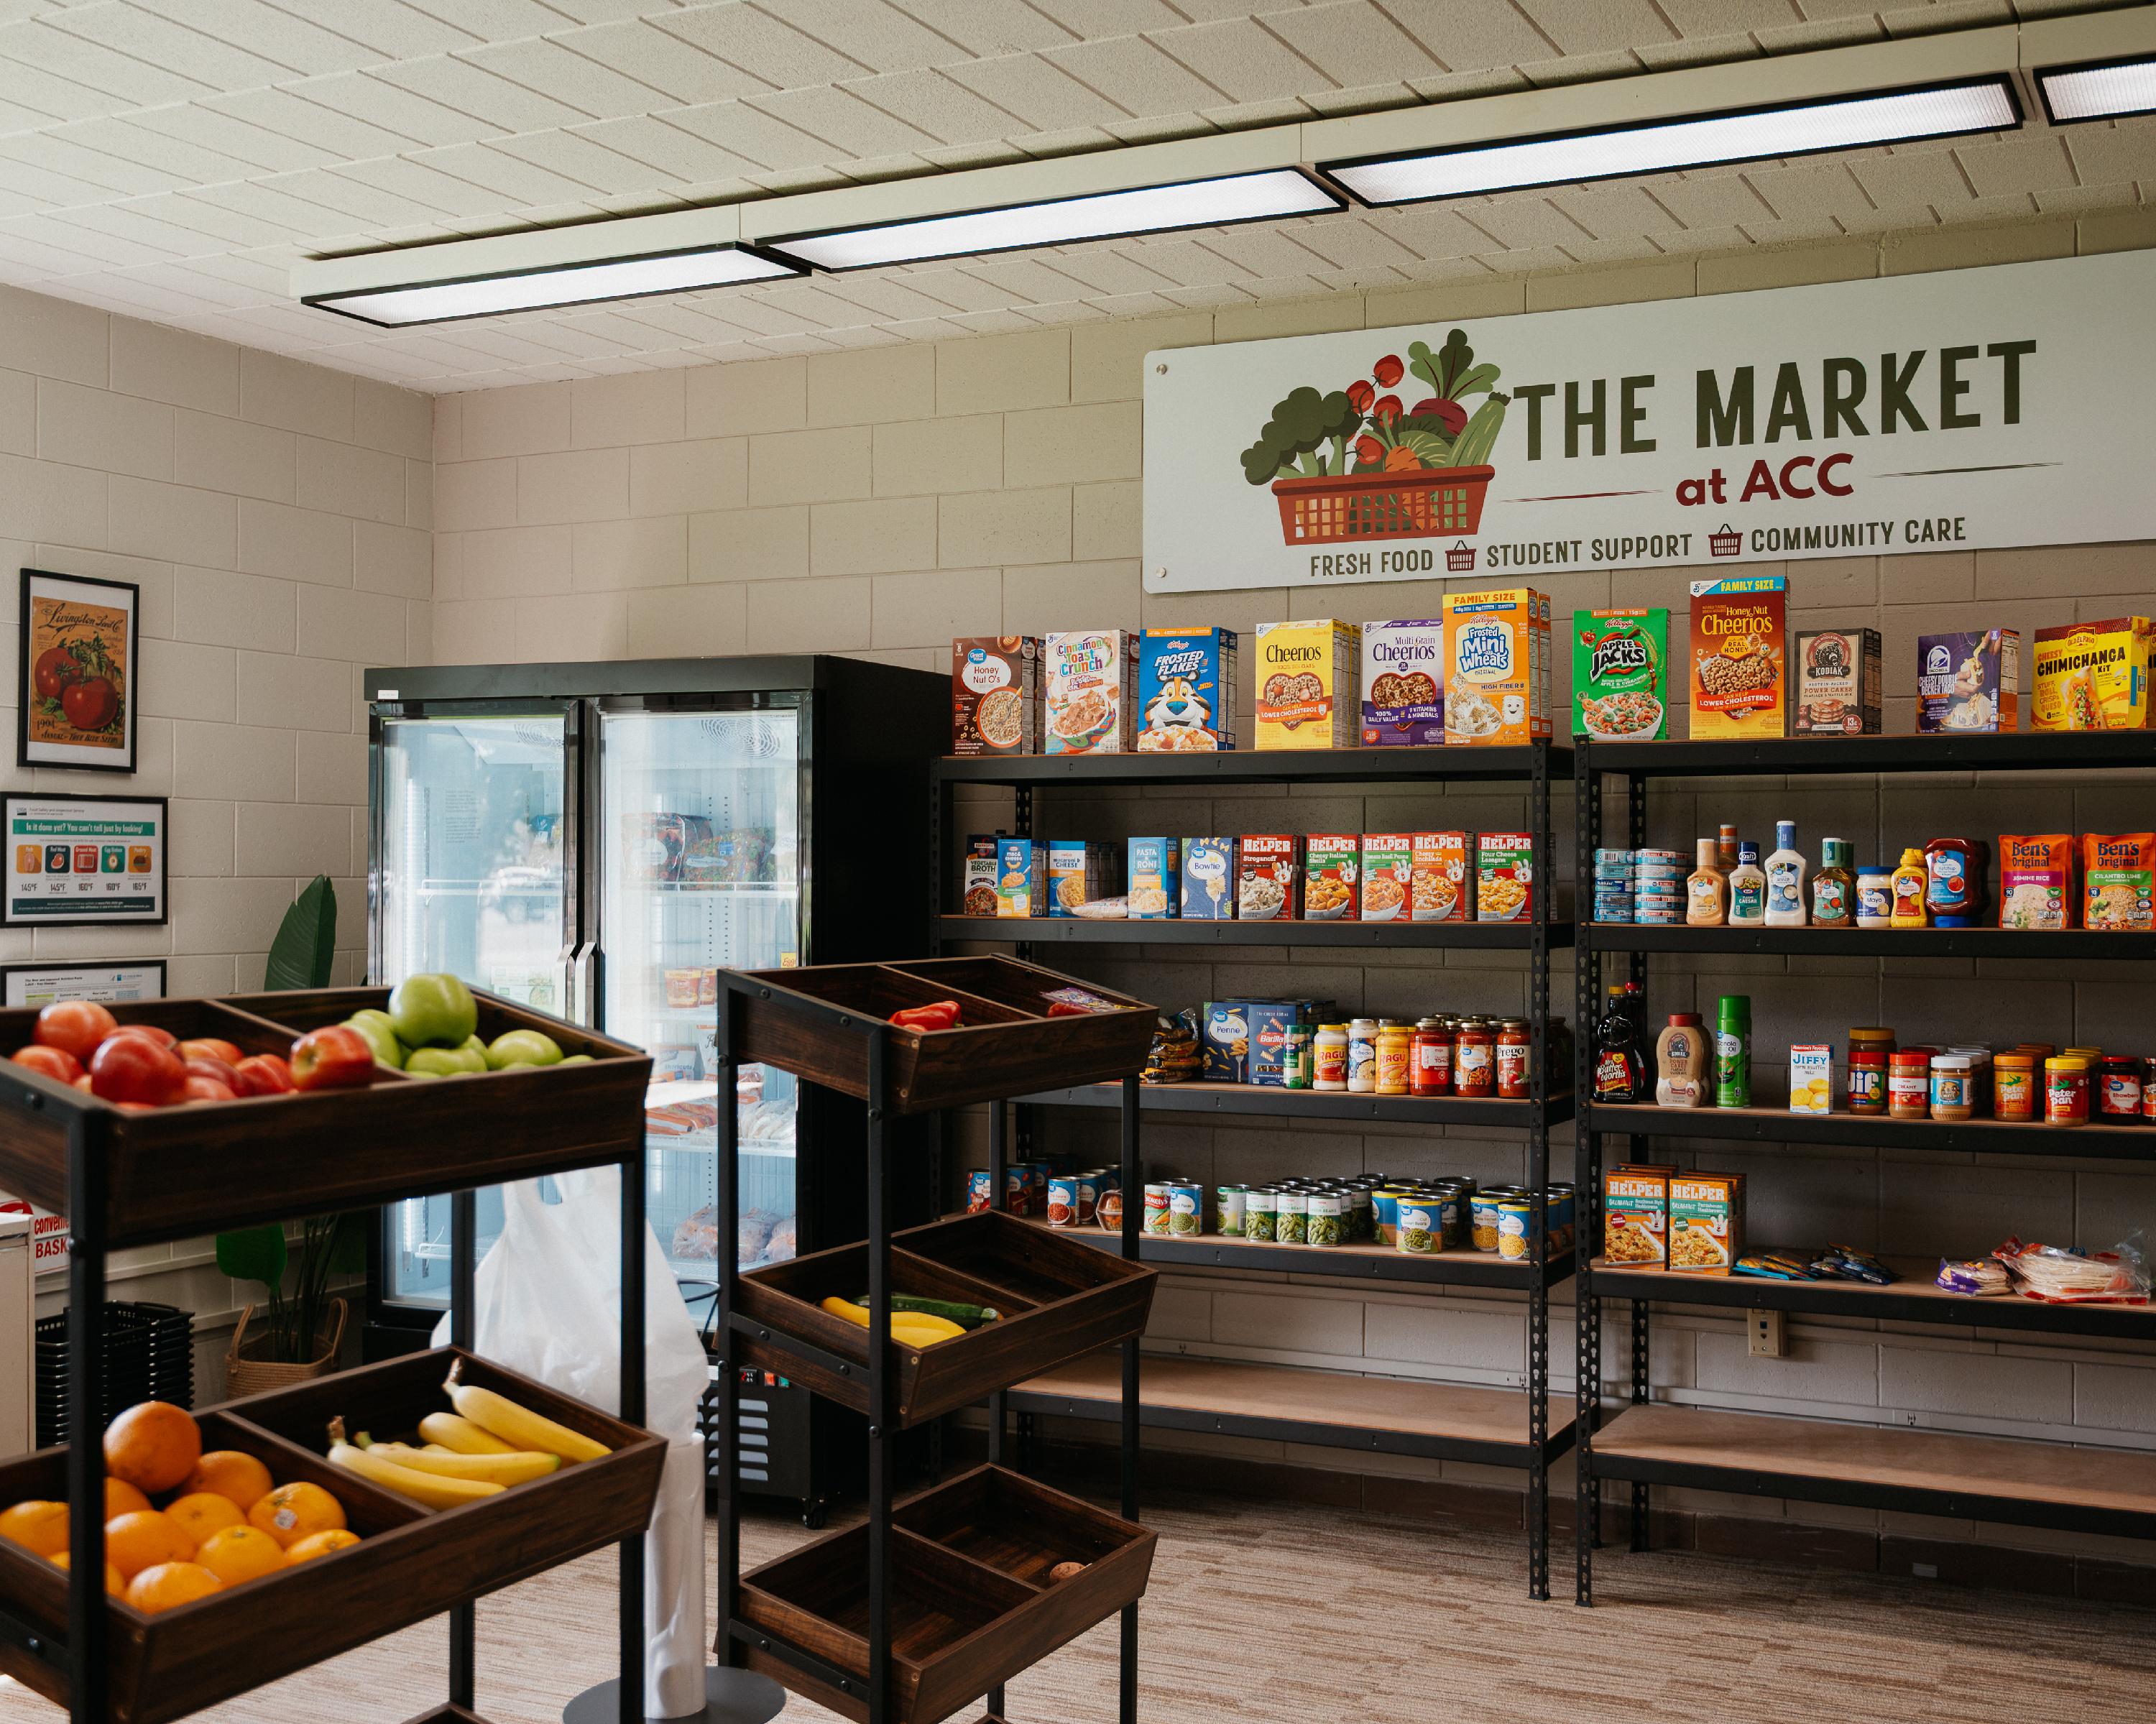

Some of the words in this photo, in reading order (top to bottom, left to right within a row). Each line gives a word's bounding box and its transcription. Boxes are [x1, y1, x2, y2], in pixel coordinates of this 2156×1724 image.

[1514, 374, 1657, 461] THE
[1696, 338, 2037, 449] MARKET
[1675, 468, 1728, 507] at
[1739, 452, 1854, 503] ACC
[1310, 553, 1371, 577] FRESH
[1381, 549, 1433, 573] FOOD
[1487, 540, 1583, 568] STUDENT
[1591, 533, 1692, 562] SUPPORT
[1751, 522, 1894, 553] COMMUNITY
[1904, 517, 1966, 544] CARE
[1720, 581, 1754, 591] FAMILY
[1754, 579, 1774, 590] SIZE
[1454, 594, 1490, 604] FAMILY
[1493, 593, 1516, 601] SIZE
[1726, 607, 1751, 617] Honey
[1753, 606, 1768, 615] Nut
[1470, 614, 1500, 625] Kellogg's
[1605, 618, 1634, 629] Kellogg's
[1701, 614, 1773, 635] Cheerios
[1470, 627, 1498, 638] Frosted
[1395, 636, 1414, 645] Multi
[1416, 635, 1435, 645] Grain
[1463, 635, 1505, 656] Mini
[1600, 640, 1634, 652] APPLE
[2067, 637, 2077, 647] OLD
[1058, 640, 1102, 655] Cinnamon
[1266, 643, 1322, 663] Cheerios
[1373, 642, 1435, 661] Cheerios
[1066, 649, 1095, 663] Toast
[1154, 650, 1204, 667] FROSTED
[1460, 650, 1508, 671] Wheats
[2037, 649, 2063, 662] CHEESY
[2037, 646, 2126, 677] CHIMICHANGA
[1061, 656, 1103, 676] Crunch
[1158, 660, 1199, 676] FLAKES
[1592, 648, 1644, 679] JACKS
[974, 666, 1000, 677] Honey
[1815, 666, 1843, 676] KODIAK
[1919, 675, 1938, 687] CHEESY
[1938, 673, 1958, 684] DOUBLE
[1921, 685, 1941, 696] DECKER
[1941, 683, 1955, 693] TACO
[1724, 695, 1774, 705] CHOLESTEROL
[1280, 706, 1318, 717] CHOLESTEROL
[2040, 701, 2062, 714] QUESO
[38, 823, 52, 831] done
[53, 823, 66, 833] yet?
[67, 823, 78, 831] You
[78, 824, 93, 832] can't
[114, 824, 121, 834] by
[1243, 839, 1291, 852] HELPER
[1309, 839, 1356, 852] HELPER
[1365, 838, 1409, 851] HELPER
[1414, 836, 1462, 849] HELPER
[1480, 836, 1531, 850] HELPER
[2098, 842, 2139, 856] Ben's
[2012, 842, 2050, 857] Ben's
[1137, 860, 1157, 869] RONI
[1194, 862, 1220, 870] Bowtie
[2012, 857, 2050, 869] Original
[2098, 856, 2139, 869] Original
[1217, 1025, 1240, 1034] Penne
[1319, 1048, 1345, 1061] RAGÚ
[1498, 1047, 1525, 1059] Prego
[1792, 1054, 1827, 1064] JIFFY
[1600, 1070, 1626, 1082] worth's
[1848, 1071, 1879, 1093] Jif
[2048, 1089, 2076, 1098] Peter
[2050, 1097, 2073, 1105] pan
[1609, 1181, 1663, 1197] HELPER
[1672, 1184, 1725, 1201] HELPER
[36, 1239, 69, 1259] BASK
